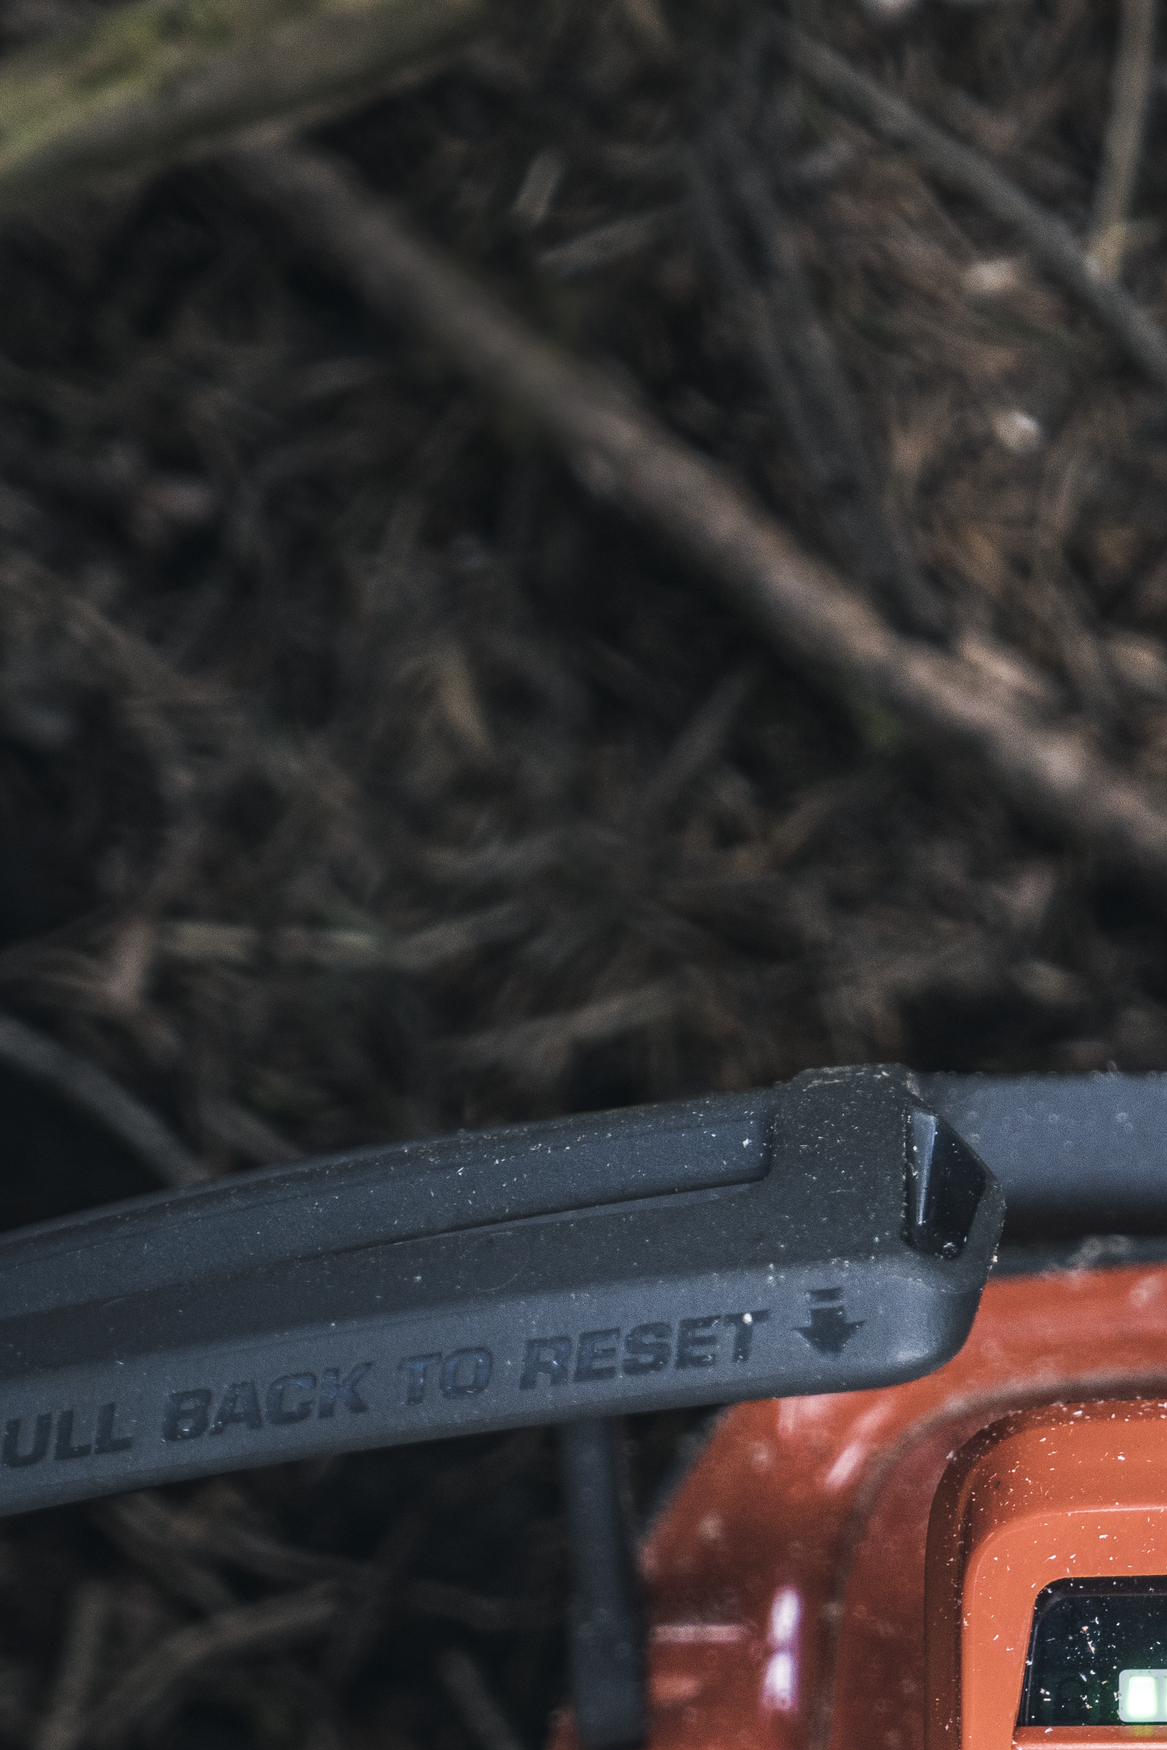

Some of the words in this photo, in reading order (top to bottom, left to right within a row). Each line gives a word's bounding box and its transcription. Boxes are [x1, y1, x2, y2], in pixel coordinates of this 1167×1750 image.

[161, 1361, 373, 1441] BACK
[401, 1346, 493, 1406] TO
[518, 1308, 771, 1391] RESET
